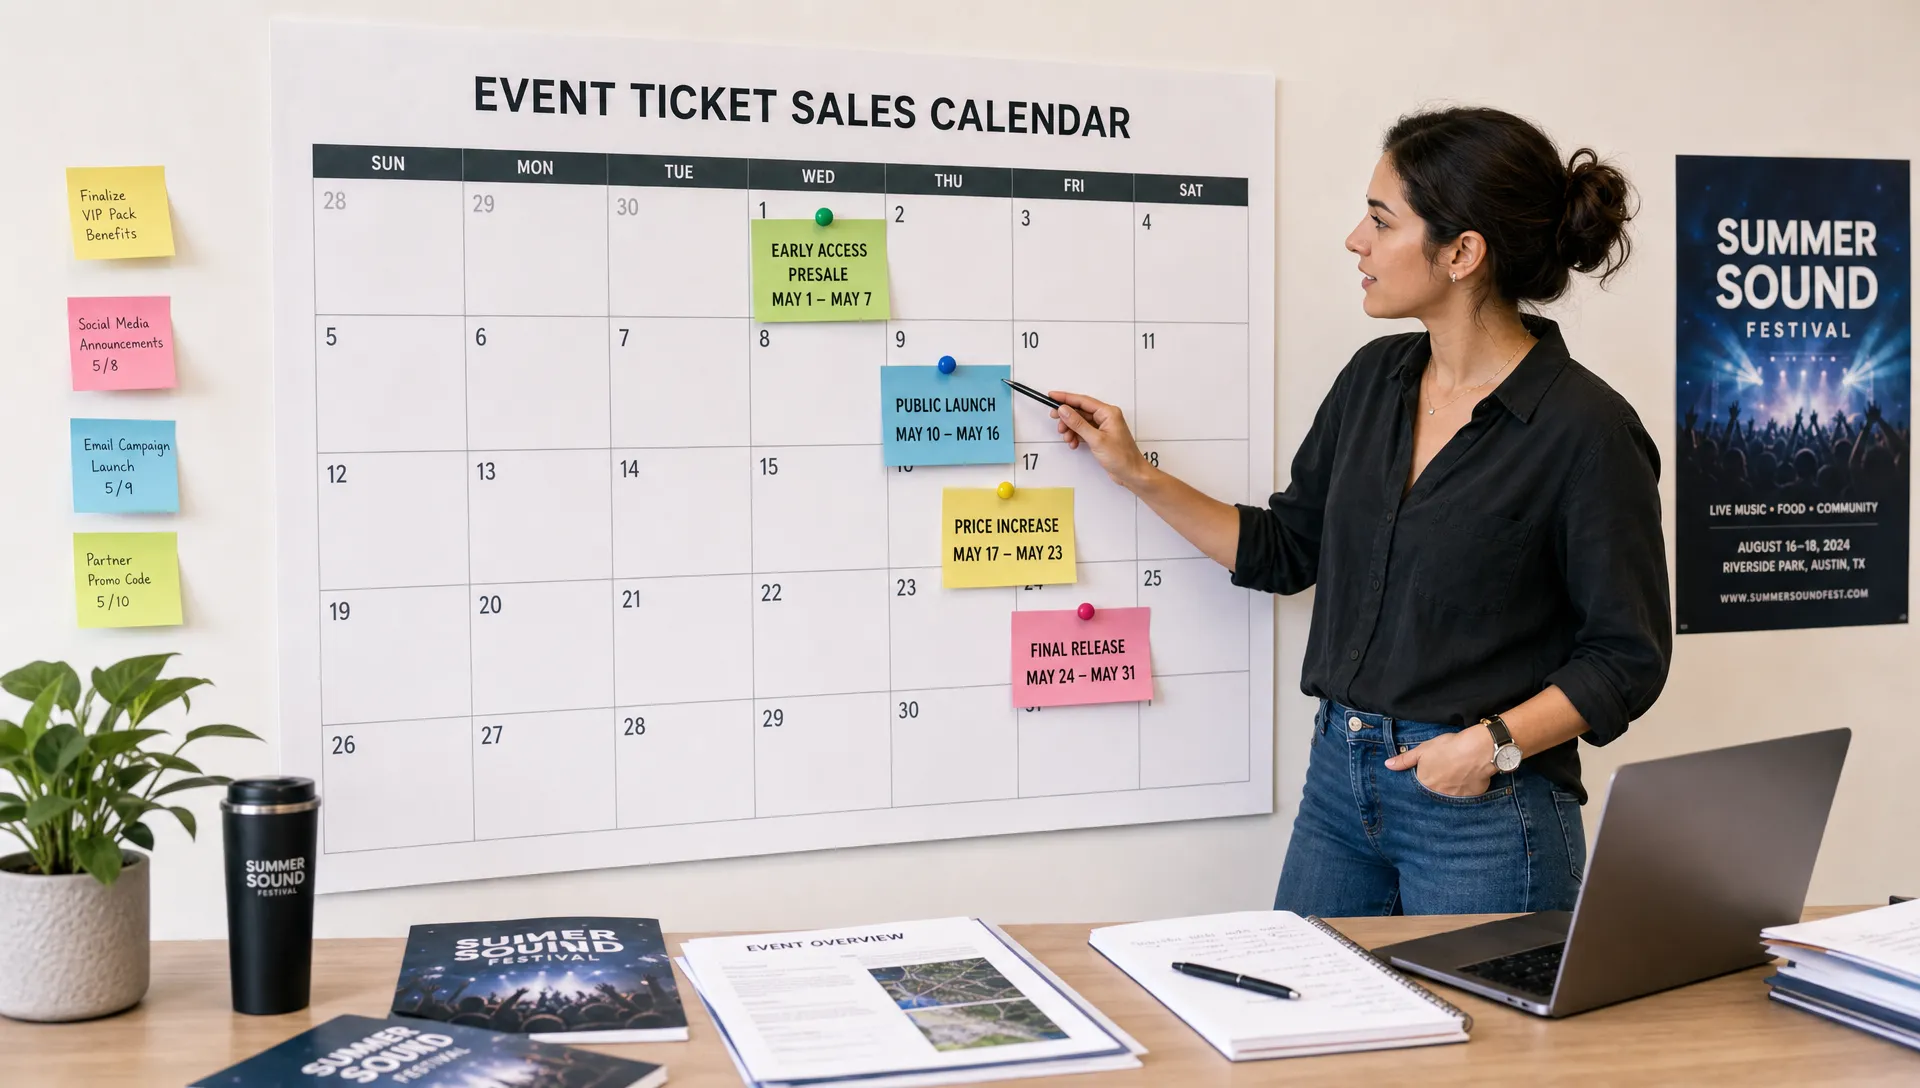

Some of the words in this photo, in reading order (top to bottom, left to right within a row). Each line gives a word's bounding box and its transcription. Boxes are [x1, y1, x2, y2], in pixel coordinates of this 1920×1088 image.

[476, 76, 615, 115] EVENT
[631, 83, 777, 122] TICKET
[792, 90, 915, 128] SALES
[931, 97, 1130, 138] CALENDAR
[372, 155, 404, 170] SUN
[518, 160, 553, 175] MON
[665, 164, 693, 179] TUE
[802, 169, 834, 183] WED
[935, 174, 962, 187] THU
[1065, 179, 1084, 192] FRI
[1180, 183, 1203, 196] SAT
[81, 189, 125, 201] Finalize
[82, 209, 102, 221] VIP
[109, 207, 136, 220] Pack
[324, 191, 346, 210] 28
[473, 195, 494, 213] 29
[617, 198, 638, 215] 30
[760, 202, 765, 218] 1
[895, 206, 904, 222] 2
[1022, 210, 1030, 226] 3
[1142, 214, 1151, 230] 4
[86, 227, 137, 241] Benefits
[1717, 218, 1877, 256] SUMMER
[772, 244, 813, 257] EARLY
[818, 243, 867, 257] ACCESS
[789, 267, 848, 281] PRESALE
[1716, 264, 1878, 309] SOUND
[773, 292, 801, 306] MAY
[807, 292, 811, 306] 1
[832, 292, 859, 306] MAY
[864, 292, 871, 305] 7
[79, 317, 110, 330] Social
[116, 317, 149, 329] Media
[1747, 322, 1850, 338] FESTIVAL
[80, 337, 163, 350] Announcements
[327, 327, 336, 346] 5
[476, 328, 486, 346] 6
[619, 329, 629, 346] 7
[760, 330, 769, 347] 8
[896, 331, 905, 348] 9
[1022, 332, 1038, 348] 10
[1142, 333, 1154, 349] 11
[93, 358, 118, 374] 5/8
[896, 398, 941, 412] PUBLIC
[946, 398, 995, 412] LAUNCH
[896, 427, 922, 441] MAY
[927, 427, 940, 441] 10
[957, 426, 982, 440] MAY
[987, 426, 999, 440] 16
[85, 438, 113, 450] Email
[119, 438, 170, 457] Campaign
[92, 459, 134, 472] Launch
[328, 465, 346, 483] 12
[477, 462, 495, 480] 13
[621, 460, 639, 477] 14
[760, 458, 778, 475] 15
[1023, 454, 1038, 470] 17
[106, 480, 132, 496] 5/9
[1710, 505, 1731, 515] LIVE
[1735, 504, 1766, 515] MUSIC
[1778, 503, 1806, 514] FOOD
[1817, 502, 1878, 513] COMMUNITY
[955, 519, 992, 534] PRICE
[997, 518, 1058, 533] INCREASE
[954, 547, 981, 561] MAY
[986, 547, 999, 561] 17
[1017, 546, 1043, 560] MAY
[1048, 545, 1062, 560] 23
[1738, 541, 1782, 553] AUGUST
[1823, 539, 1850, 551] 2024
[87, 553, 132, 566] Partner
[1723, 560, 1775, 573] RIVERSIDE
[1779, 560, 1808, 572] PARK,
[1811, 559, 1850, 570] AUSTIN,
[1853, 558, 1865, 568] TX
[88, 574, 120, 586] Promo
[125, 573, 151, 584] Code
[98, 594, 129, 610] 5/10
[330, 602, 350, 620] 19
[480, 596, 501, 614] 20
[623, 590, 639, 608] 21
[762, 584, 781, 601] 22
[897, 579, 916, 596] 23
[1145, 570, 1161, 586] 25
[1721, 589, 1868, 603] WWW.SUMMERSOUNDFEST.COM
[1031, 642, 1067, 657] FINAL
[1072, 639, 1125, 655] RELEASE
[1027, 669, 1055, 685] MAY
[1059, 668, 1074, 683] 24
[1091, 666, 1118, 682] MAY
[1122, 666, 1134, 680] 31
[333, 735, 355, 754] 26
[482, 726, 502, 744] 27
[624, 717, 645, 735] 28
[763, 709, 783, 727] 29
[899, 701, 918, 718] 30
[246, 857, 305, 872] SUMMER
[246, 870, 305, 888] SOUND
[257, 887, 298, 897] FESTIVAL
[746, 941, 804, 952] EVENT
[810, 932, 905, 947] OVERVIEW
[488, 954, 600, 966] FESTIVAL
[340, 1033, 454, 1084] SOUND
